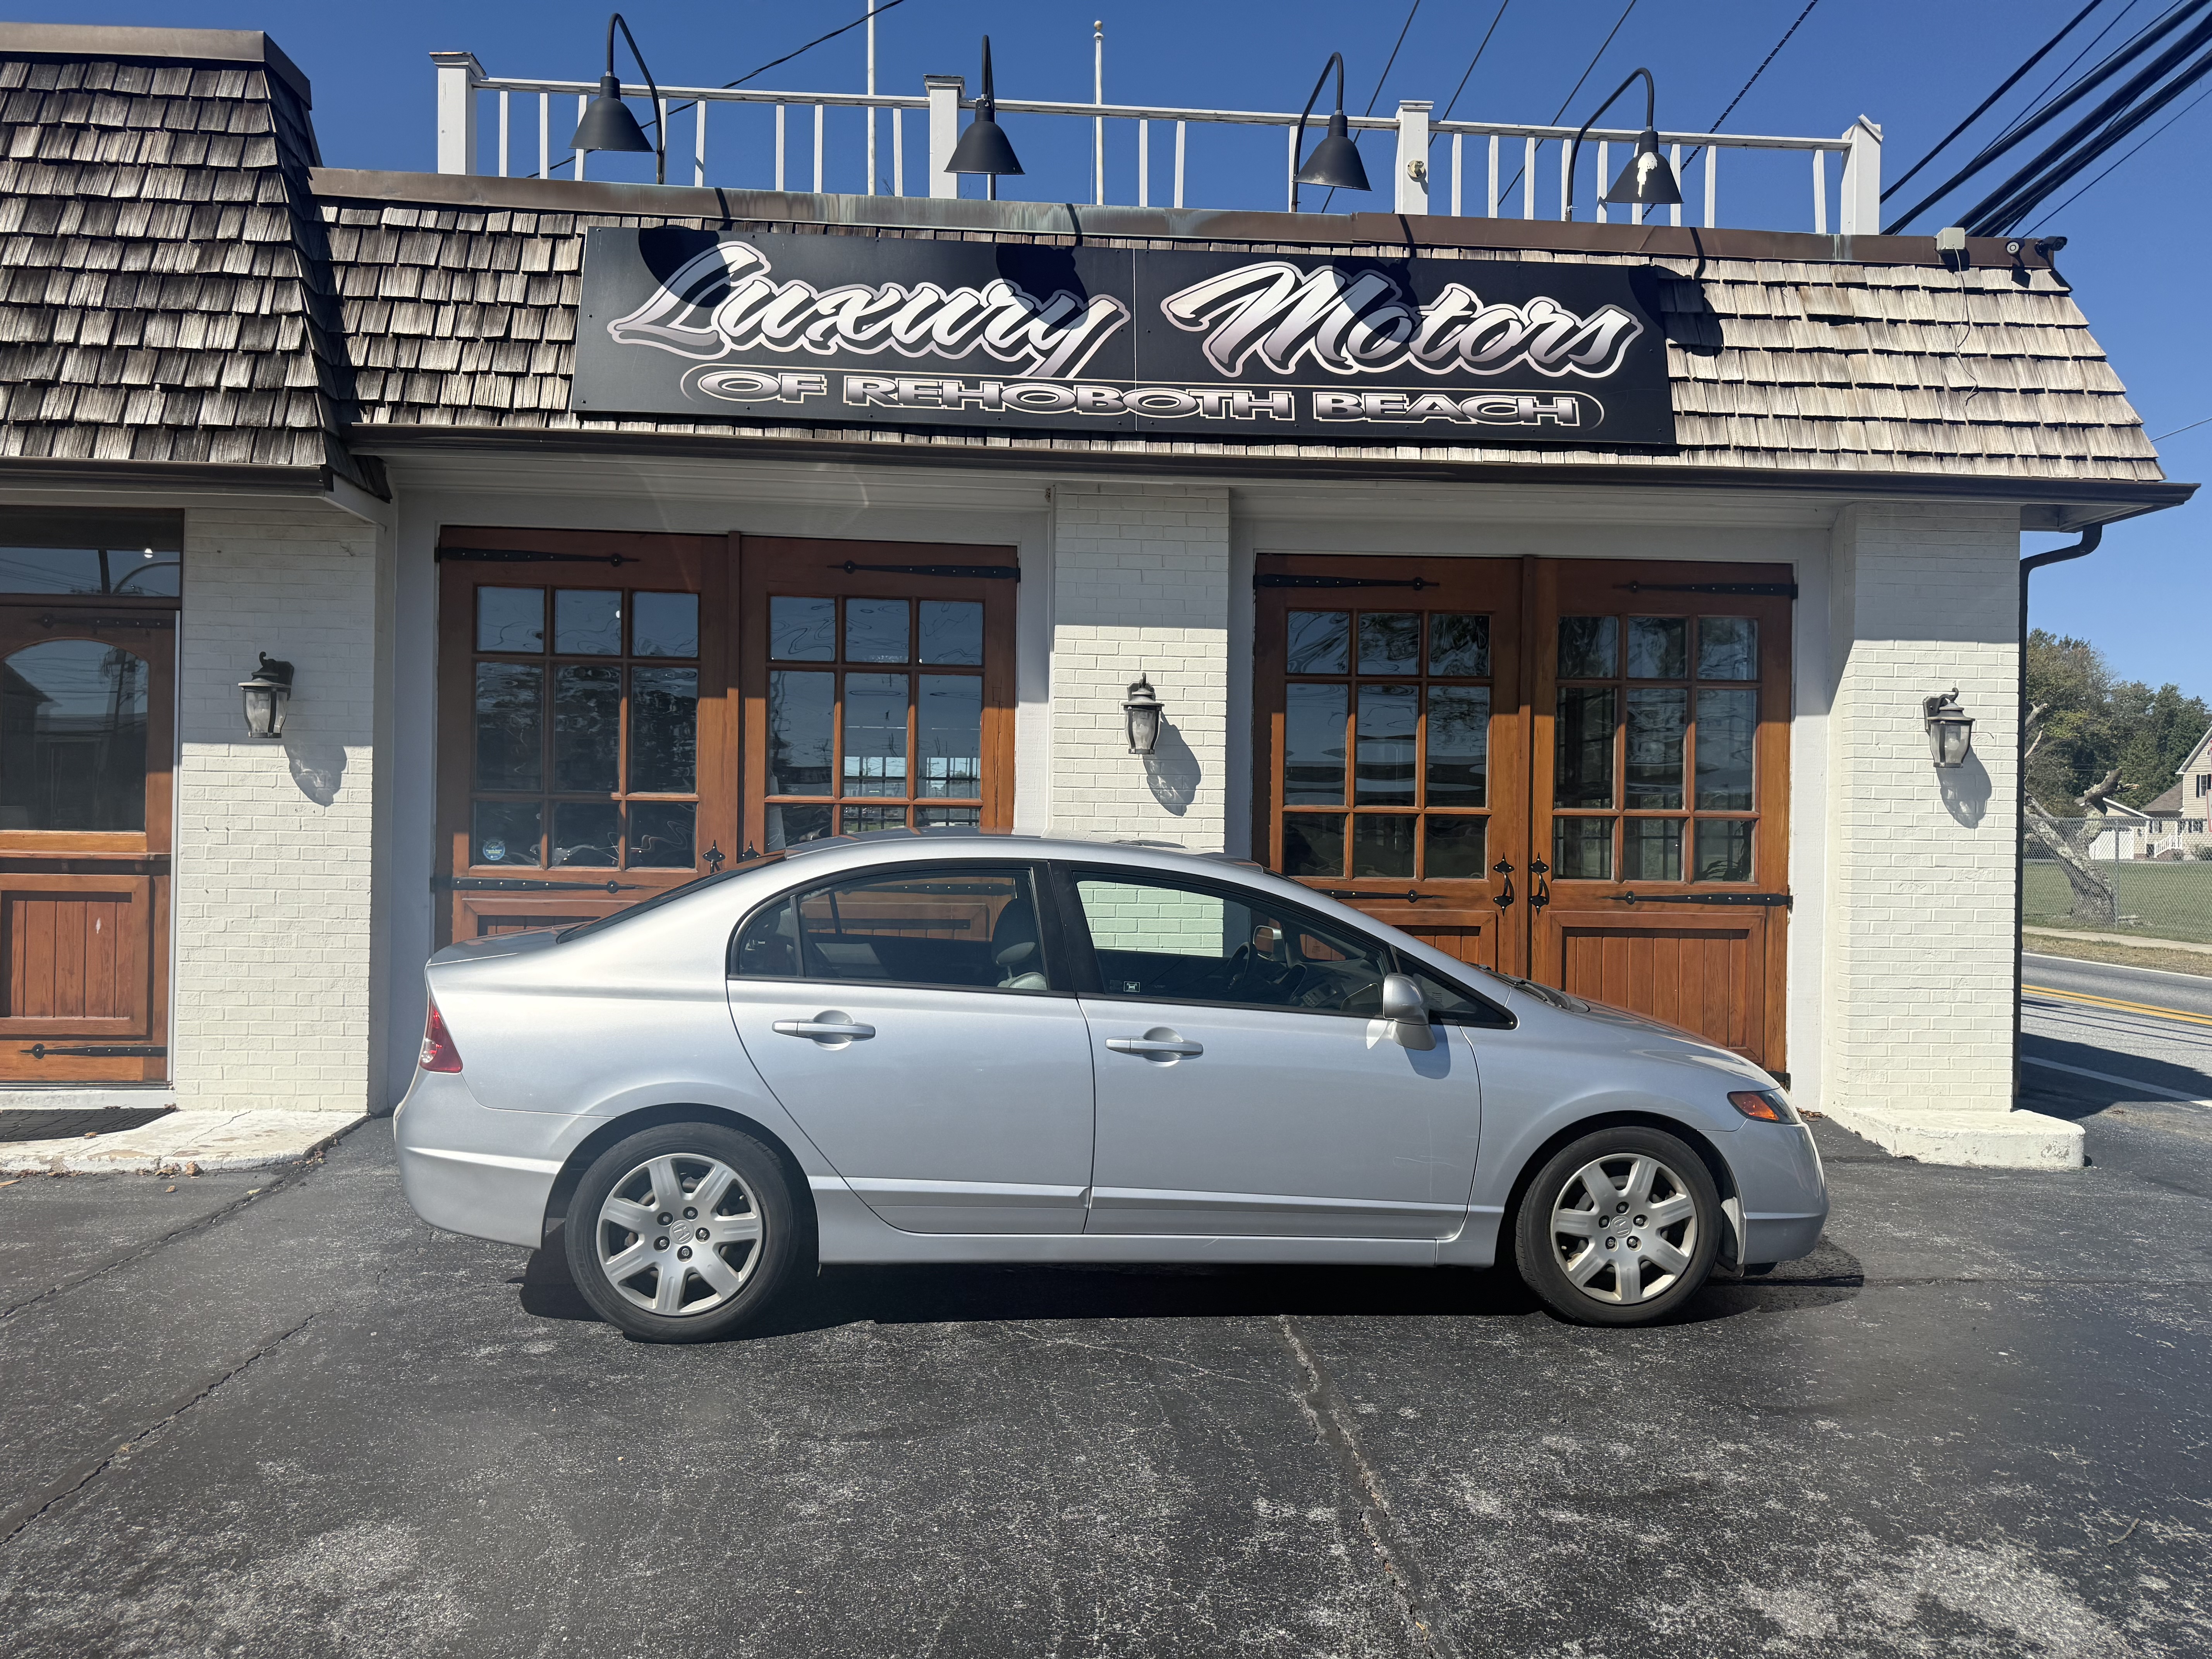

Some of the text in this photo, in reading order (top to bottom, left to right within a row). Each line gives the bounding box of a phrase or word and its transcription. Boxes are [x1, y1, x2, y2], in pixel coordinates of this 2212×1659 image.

[607, 241, 1644, 379] Luxury Motors
[697, 370, 1581, 427] OF REHOBOTH BEACH
